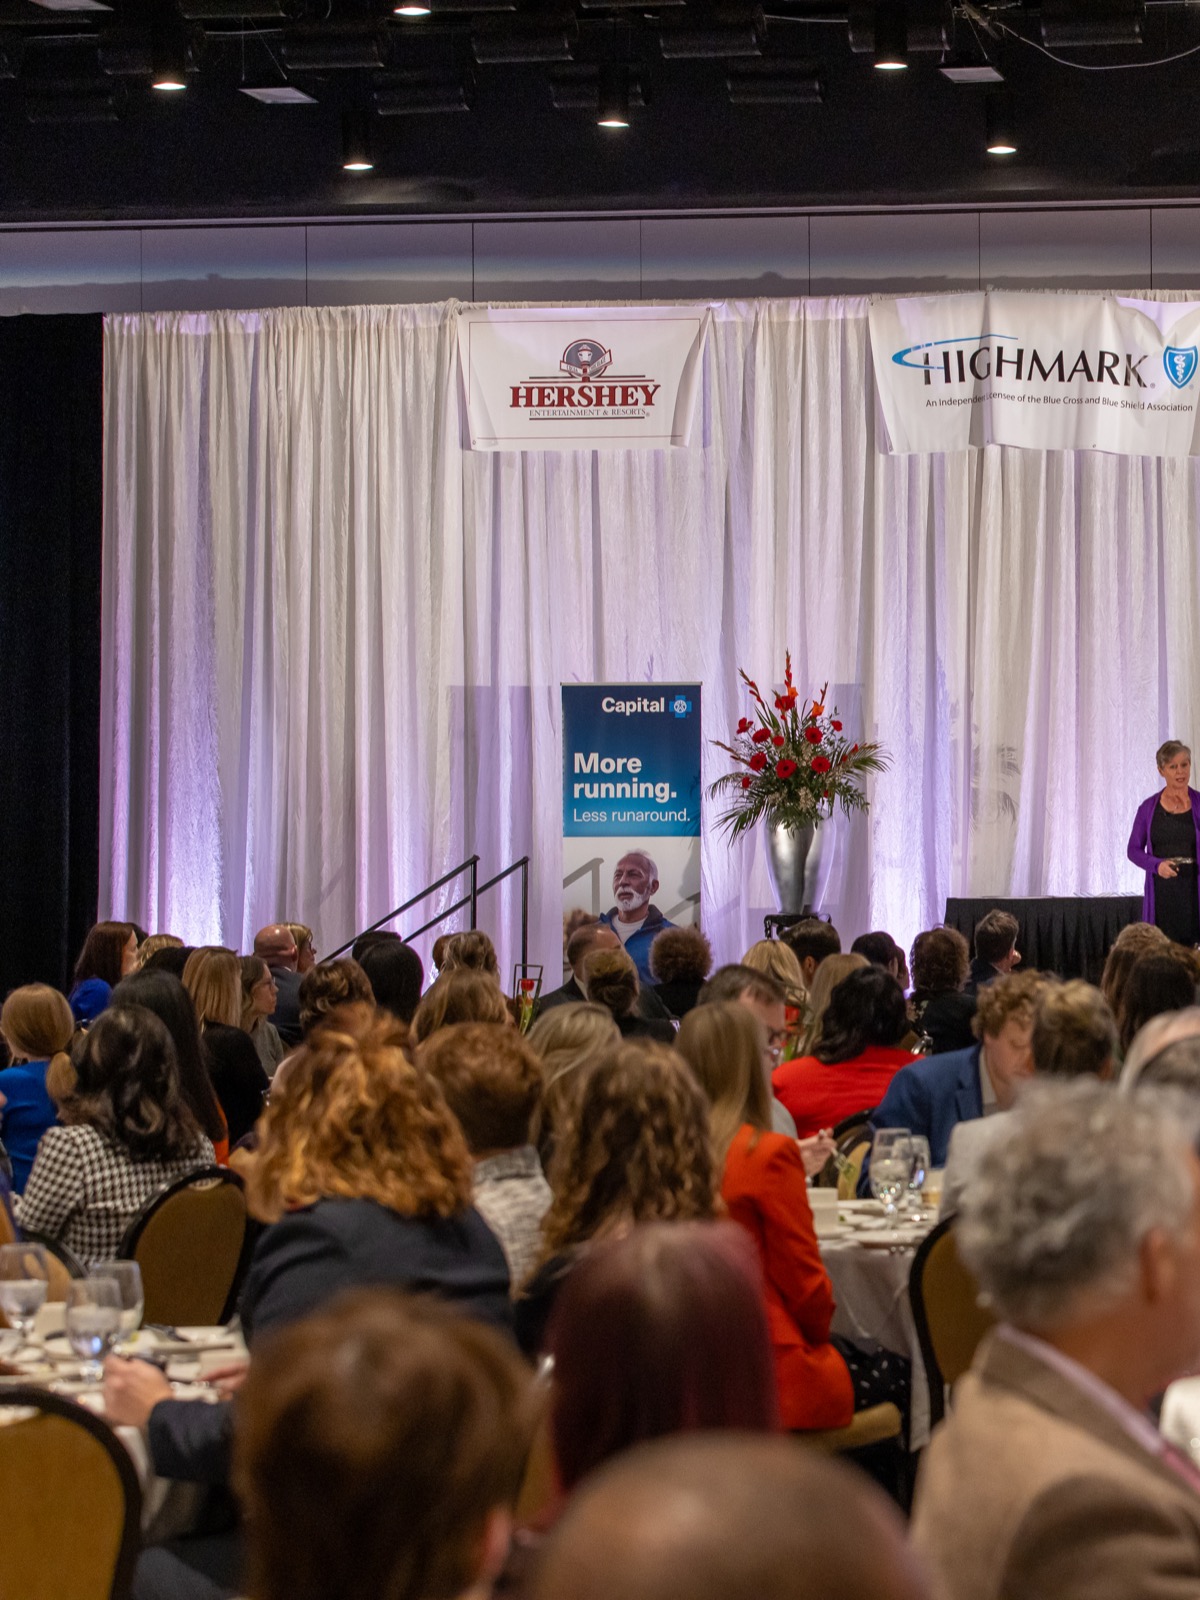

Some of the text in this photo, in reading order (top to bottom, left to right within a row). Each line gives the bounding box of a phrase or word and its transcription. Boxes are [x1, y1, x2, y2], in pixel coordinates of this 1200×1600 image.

[923, 346, 1148, 388] HIGHMARK
[509, 385, 661, 408] HERSHEY
[926, 399, 937, 407] An
[1027, 395, 1041, 403] the
[1043, 396, 1061, 404] Blue
[1062, 396, 1082, 404] Cross
[1084, 396, 1100, 404] and
[1102, 397, 1118, 407] Blue
[1120, 402, 1145, 410] Shield
[1147, 403, 1193, 411] Association
[529, 409, 600, 417] ENTERTAINMENT
[602, 408, 609, 416] &
[602, 697, 665, 716] Capital
[574, 752, 642, 774] More
[573, 777, 677, 803] running.
[573, 808, 691, 822] Less runaround.
